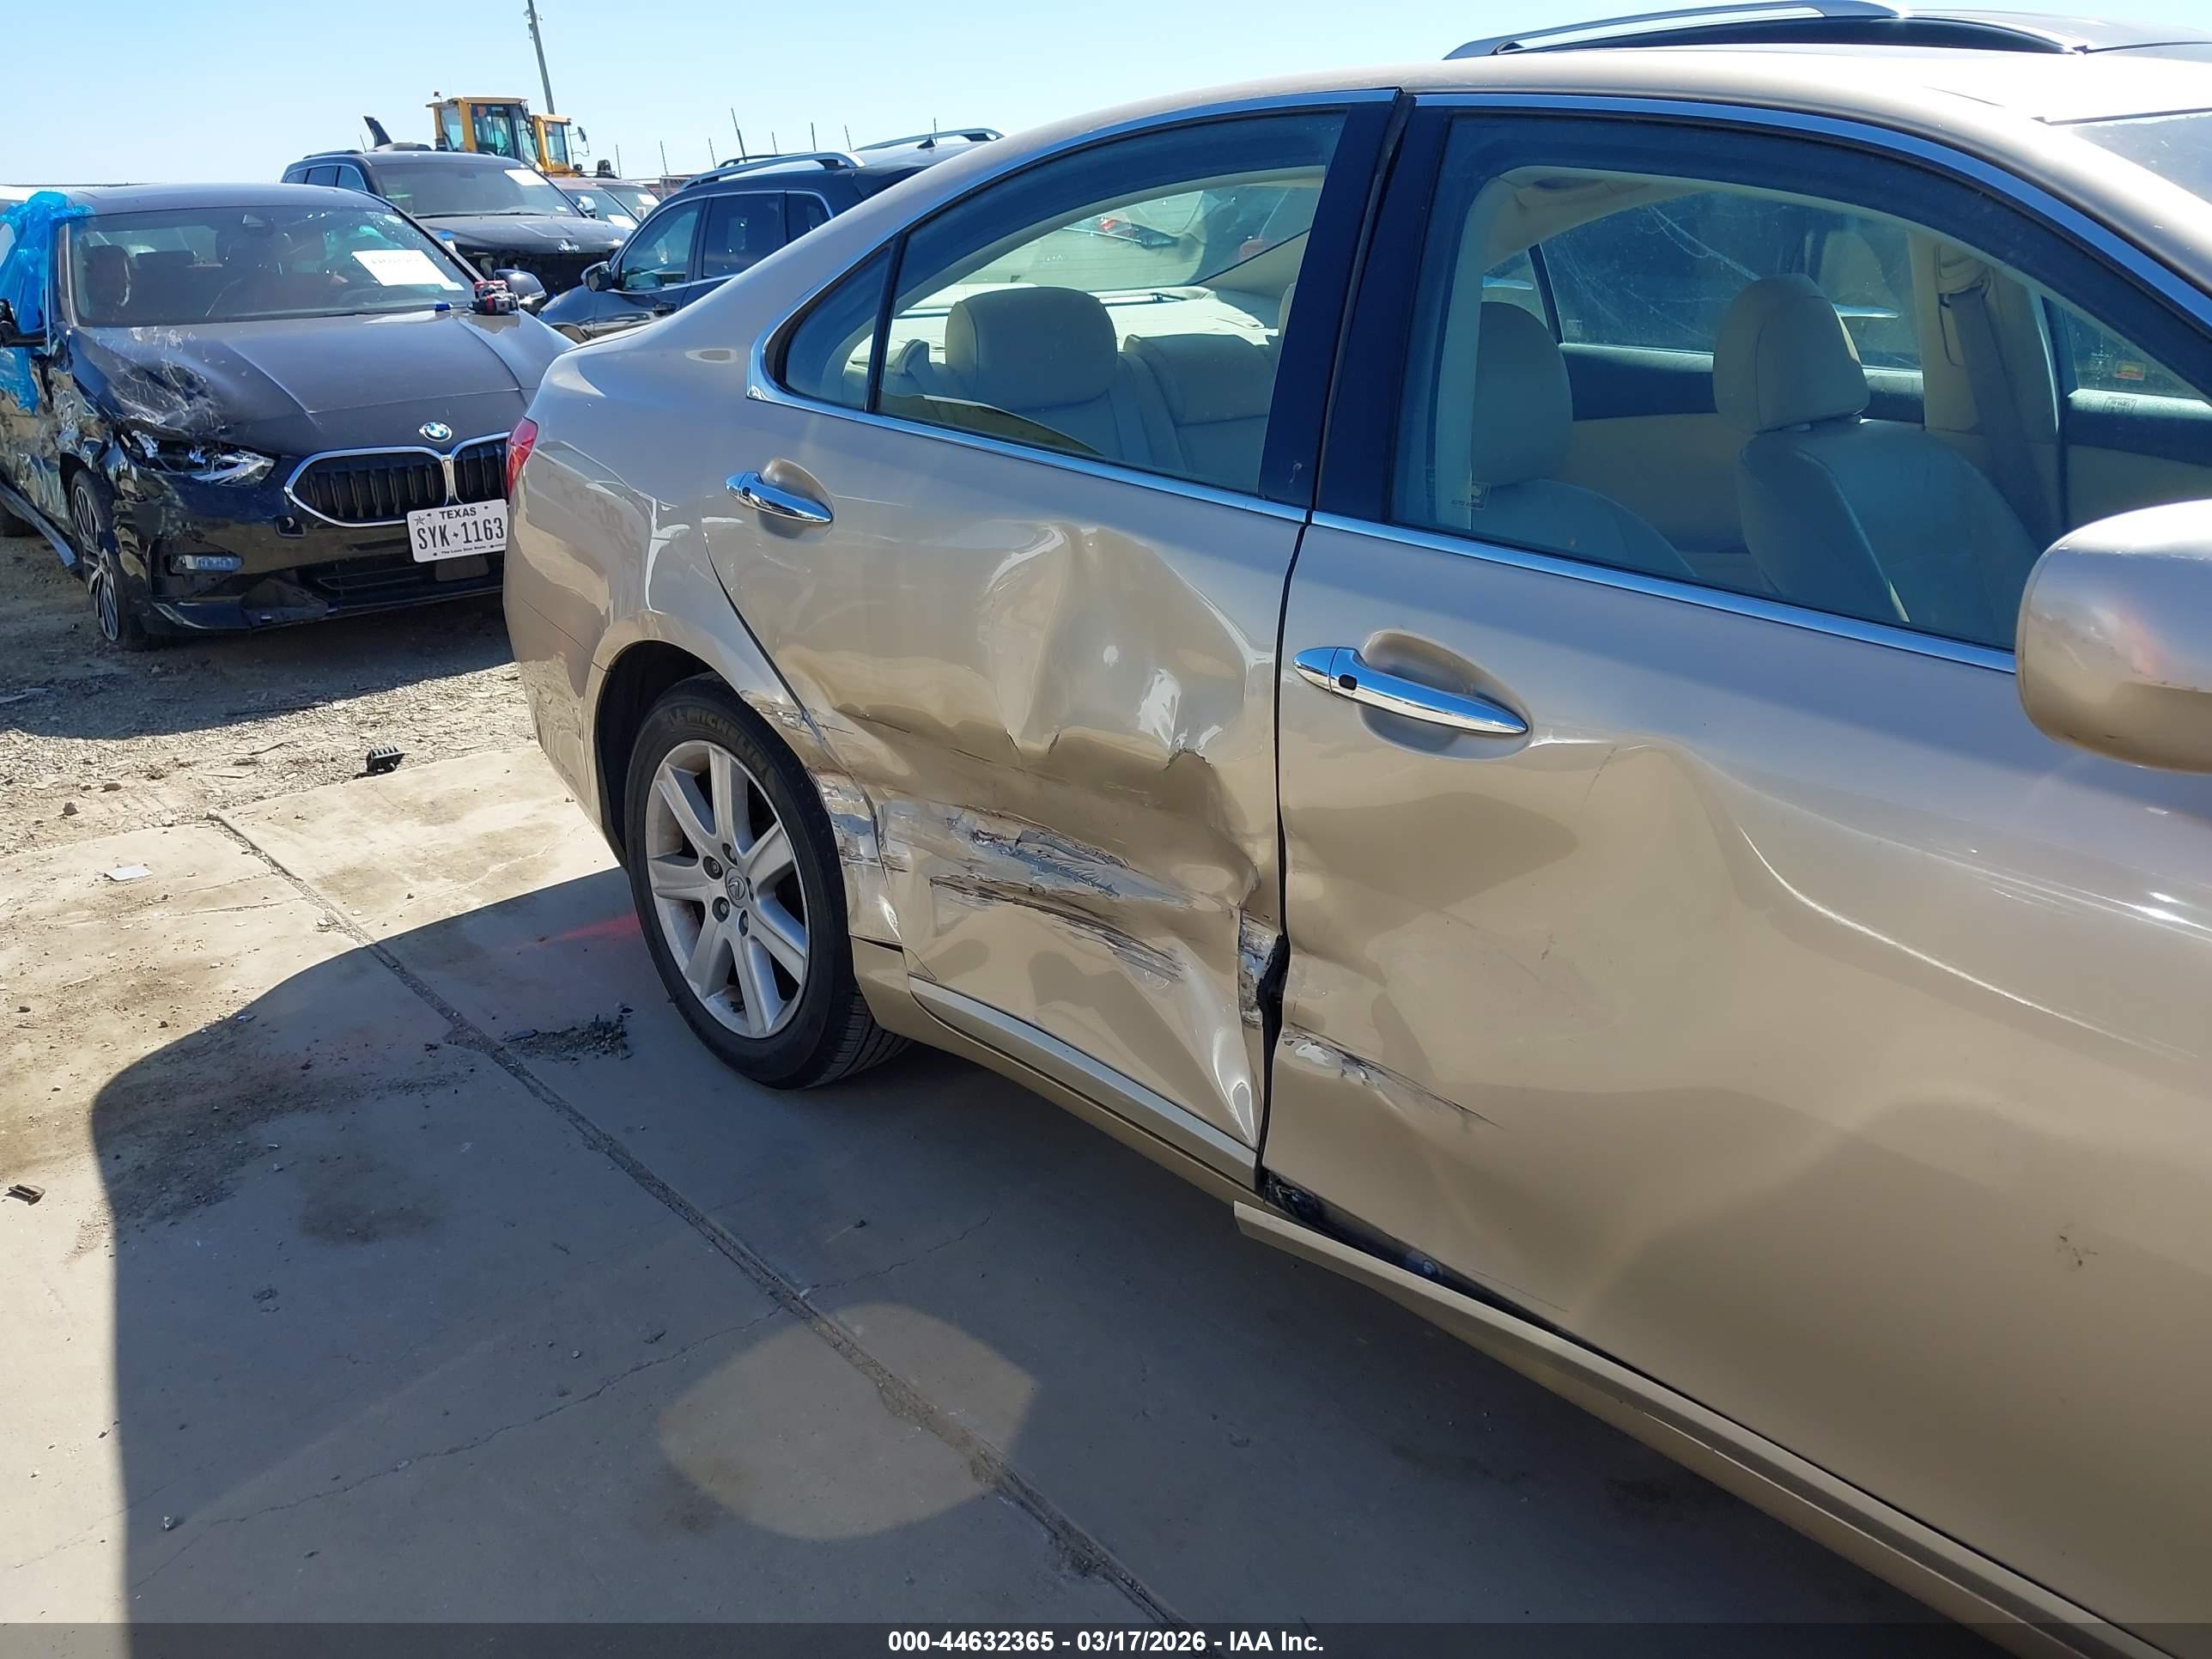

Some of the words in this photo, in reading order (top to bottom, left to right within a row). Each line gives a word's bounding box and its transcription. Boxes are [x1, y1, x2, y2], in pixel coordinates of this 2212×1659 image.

[439, 507, 477, 520] TEXAS
[417, 525, 450, 550] SYK
[461, 518, 504, 544] 1163
